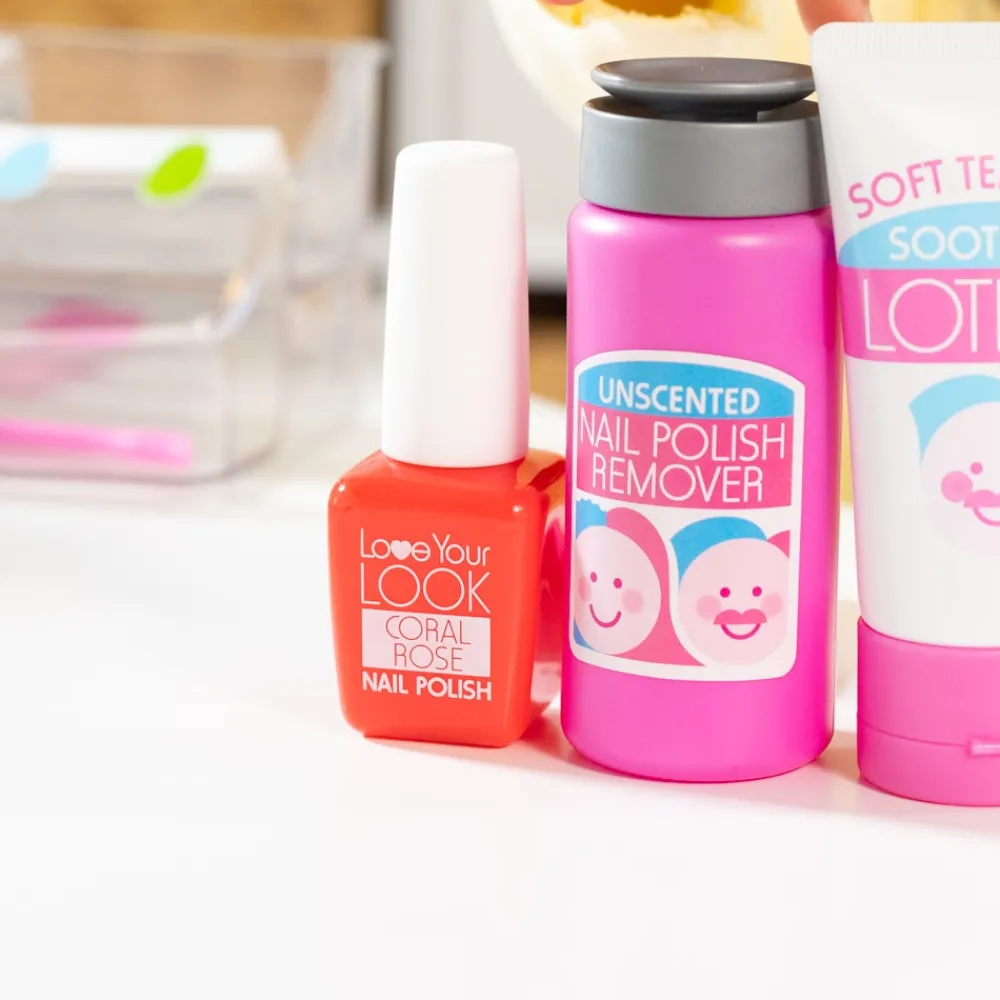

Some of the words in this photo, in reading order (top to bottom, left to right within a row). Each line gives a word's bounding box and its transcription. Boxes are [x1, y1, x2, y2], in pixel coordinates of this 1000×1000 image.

[848, 159, 943, 219] SOFT
[599, 375, 760, 415] UNSCENTED
[580, 406, 641, 456] NAIL
[652, 421, 785, 462] POLISH
[592, 452, 763, 503] REMOVER
[432, 533, 491, 566] Your
[360, 562, 491, 614] LOOK
[385, 615, 471, 644] CORAL
[394, 643, 463, 671] ROSE
[362, 671, 409, 694] NAIL
[416, 676, 492, 701] POLISH
